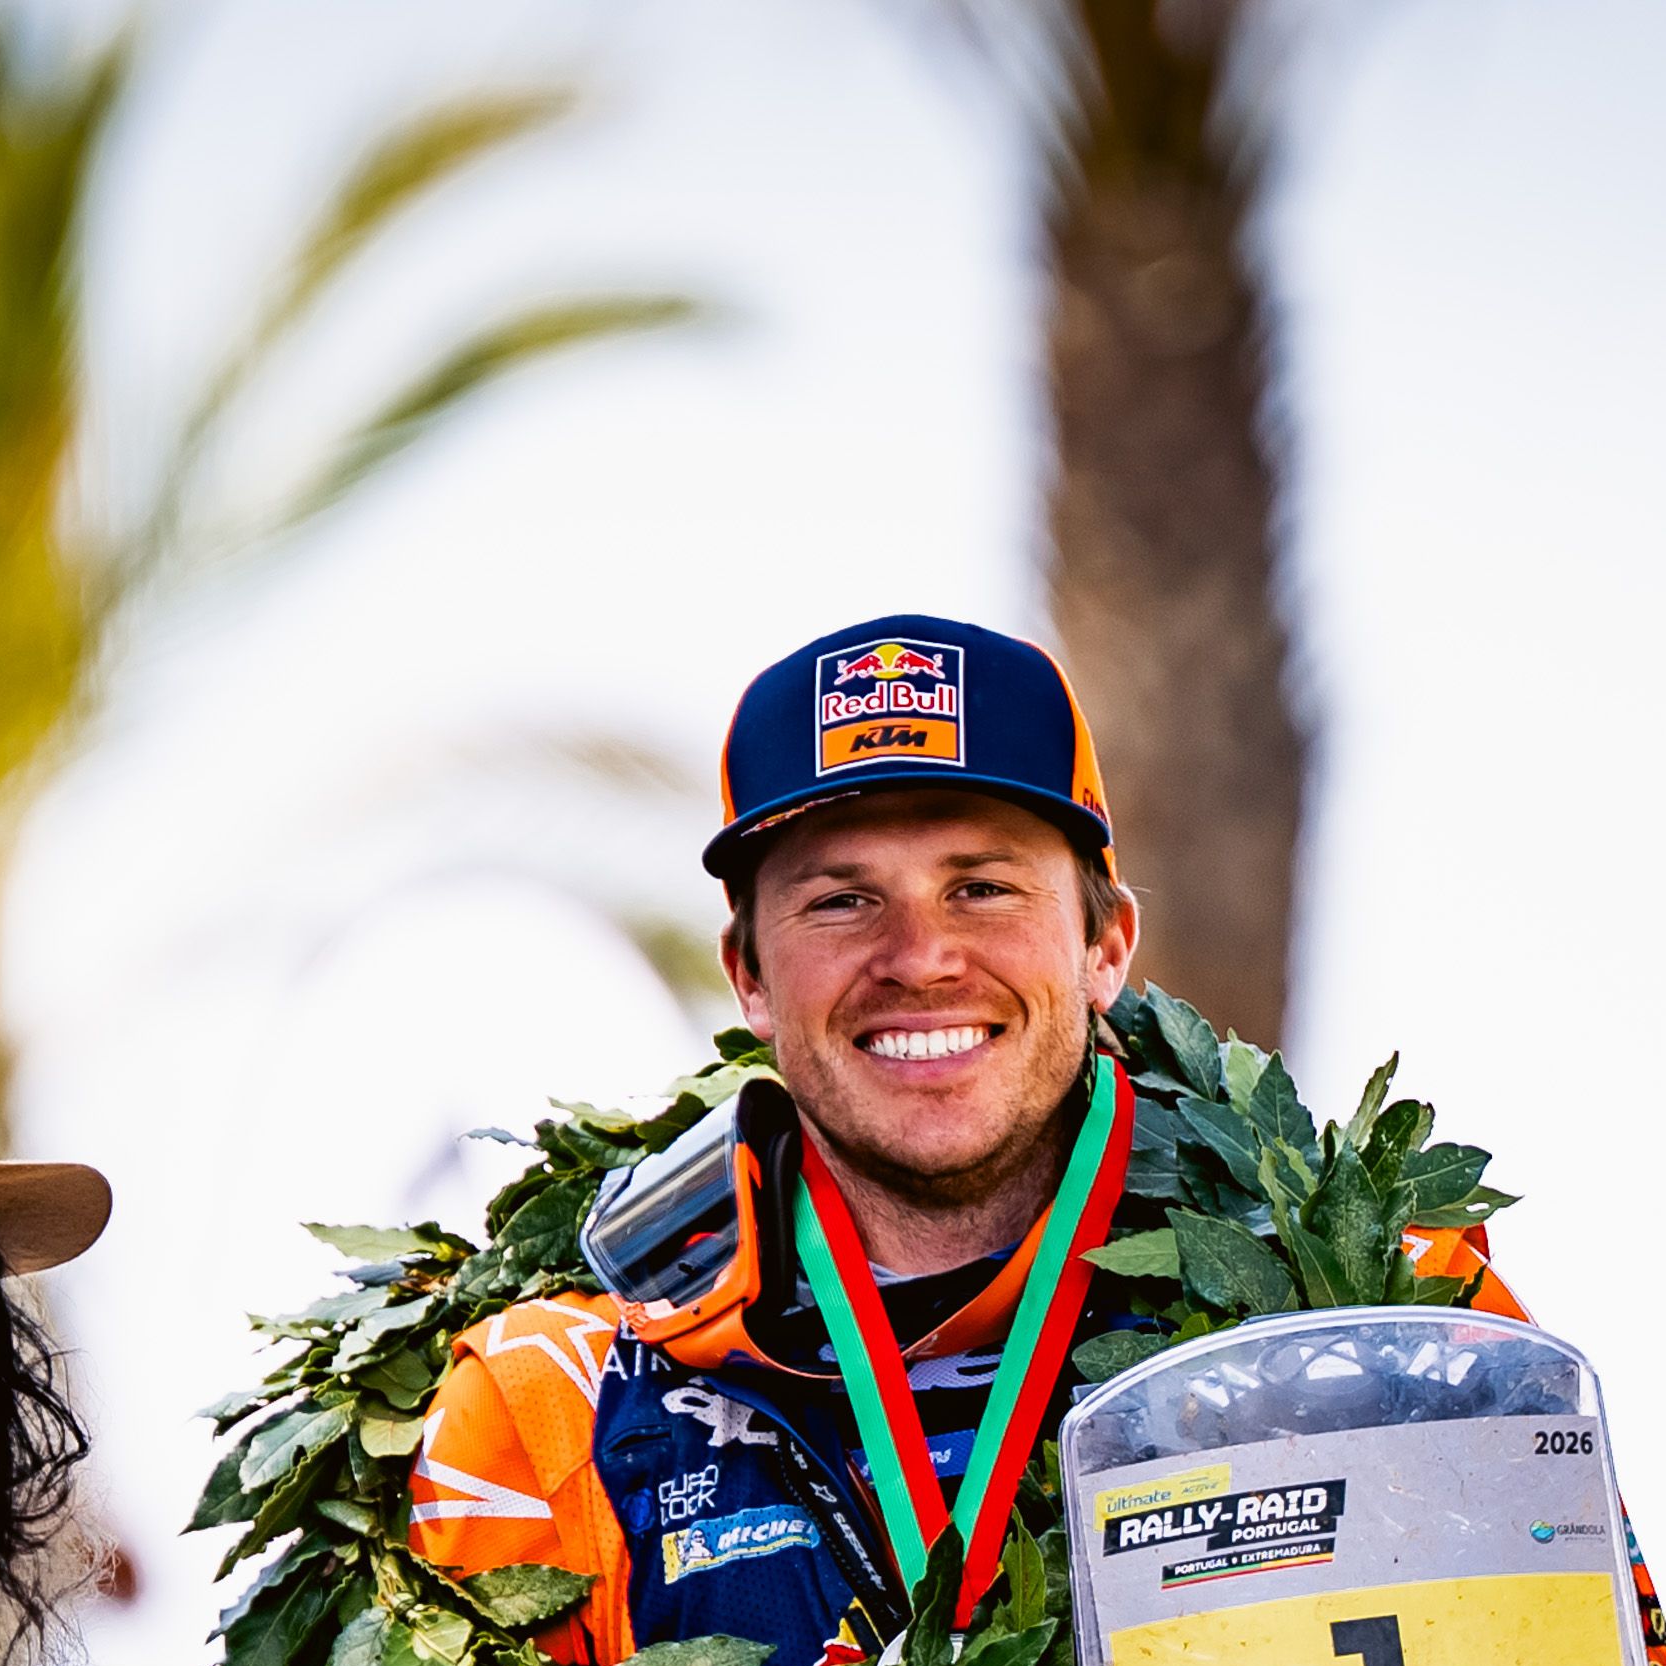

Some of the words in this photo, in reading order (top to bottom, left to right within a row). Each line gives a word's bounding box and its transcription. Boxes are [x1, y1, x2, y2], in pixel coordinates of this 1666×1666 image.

[822, 681, 888, 725] Red
[889, 681, 957, 717] Bull
[850, 725, 928, 753] KTM
[1535, 1431, 1593, 1455] 2026
[1120, 1487, 1328, 1548] RALLY-RAID
[1232, 1517, 1321, 1543] PORTUGAL
[1174, 1557, 1229, 1576] PORTUGAL
[1241, 1543, 1321, 1564] EXTREMADURA
